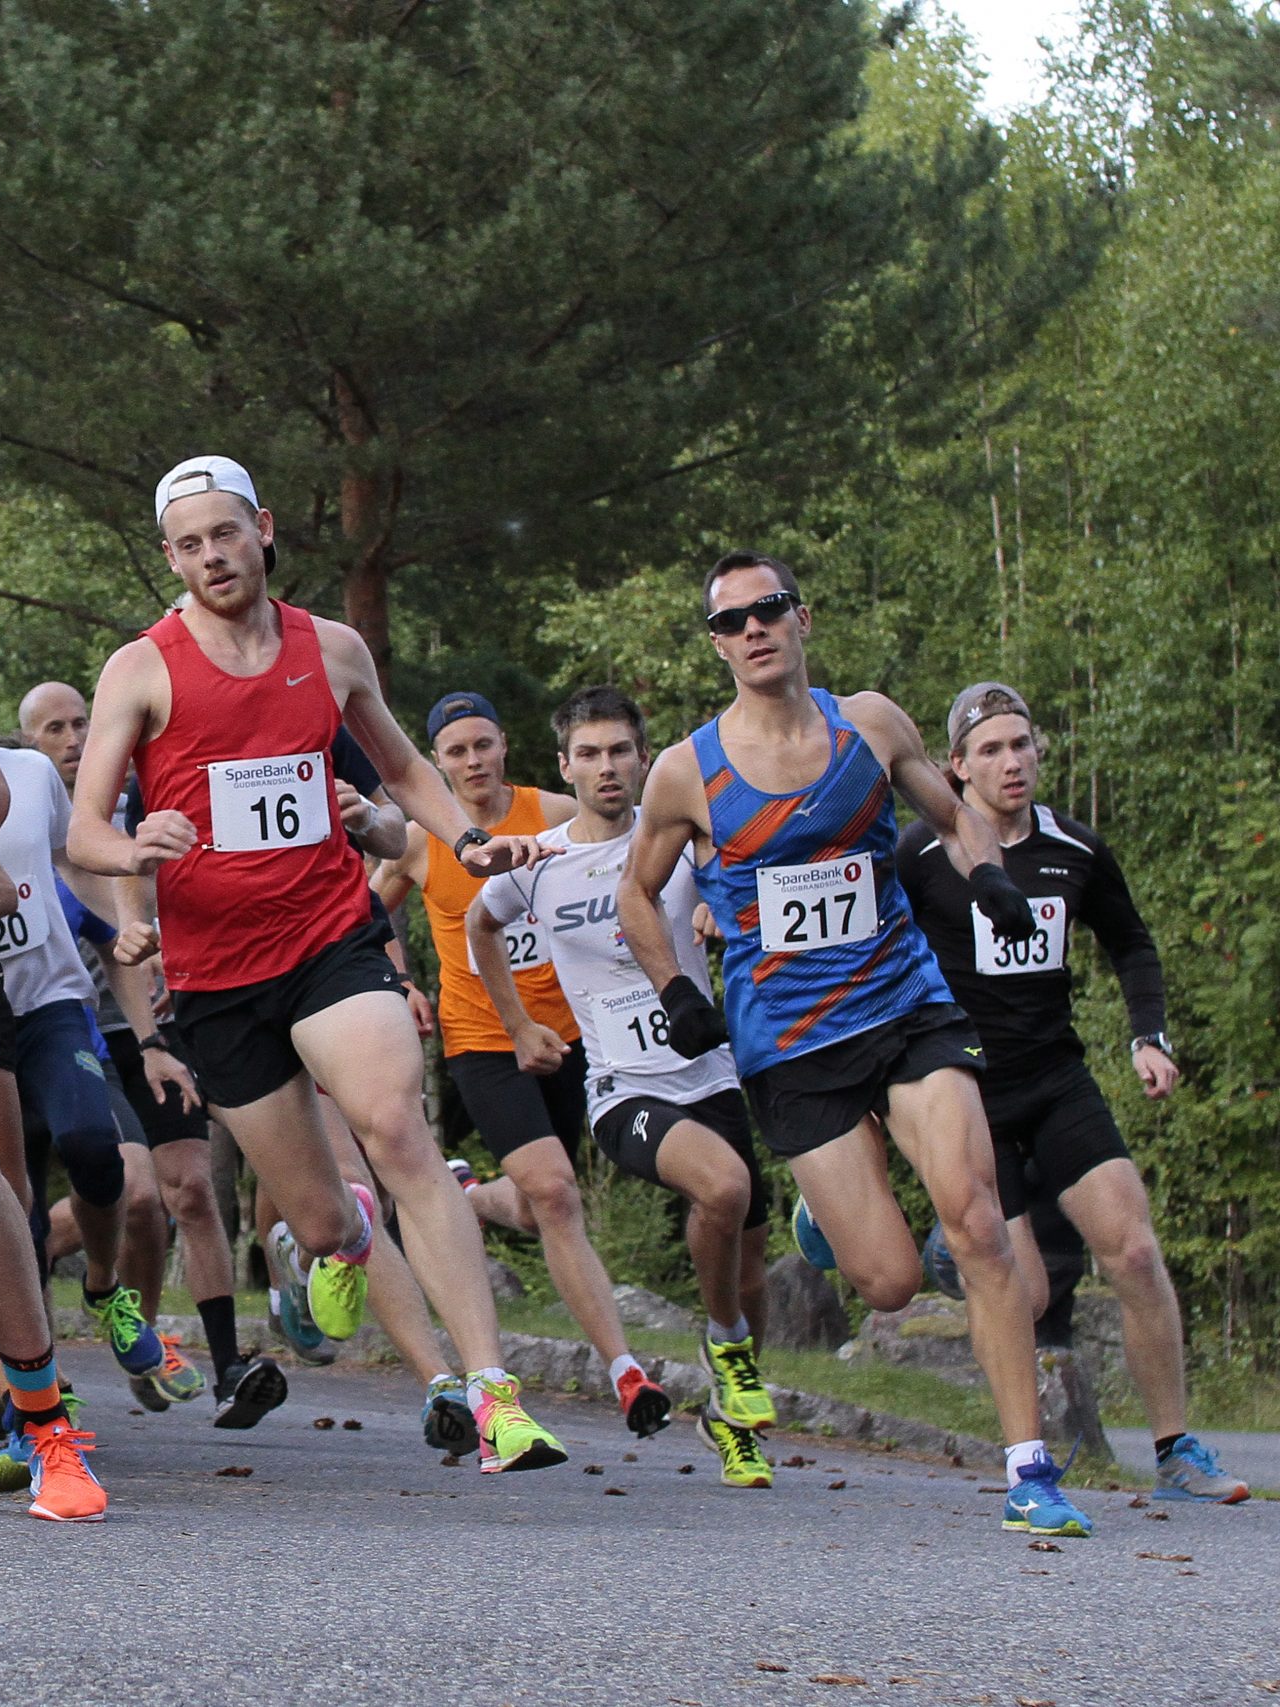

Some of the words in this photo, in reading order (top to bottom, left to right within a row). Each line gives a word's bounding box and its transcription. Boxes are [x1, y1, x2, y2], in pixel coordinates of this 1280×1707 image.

[225, 763, 295, 783] SpareBank
[233, 777, 296, 790] GUDBRANDSDAL
[250, 793, 300, 841] 16
[773, 866, 842, 886] SpareBank
[781, 880, 843, 894] GUDBRANDSDAL
[783, 891, 857, 943] 217
